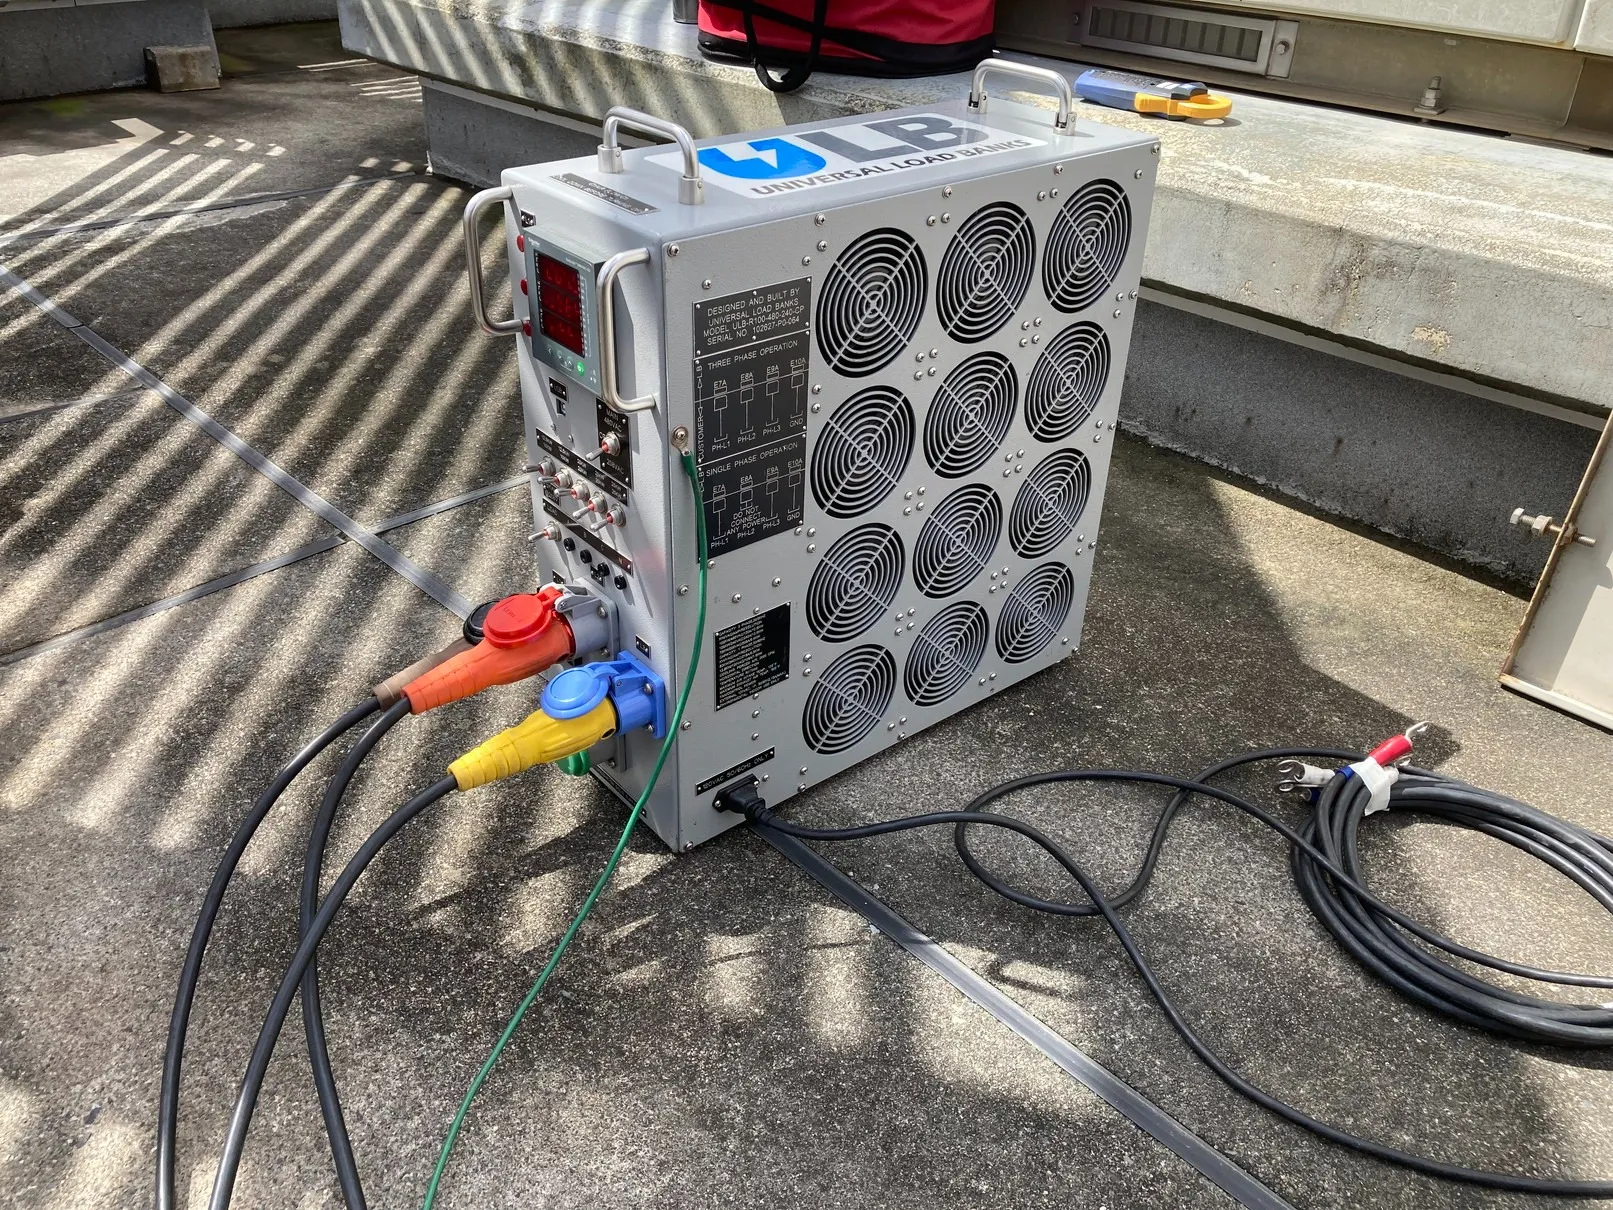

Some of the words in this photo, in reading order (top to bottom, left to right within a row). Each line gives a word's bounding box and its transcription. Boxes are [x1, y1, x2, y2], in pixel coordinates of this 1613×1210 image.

[750, 164, 895, 195] UNIVERSAL
[890, 152, 954, 170] LOAD
[956, 138, 1032, 157] BANKS
[707, 300, 746, 317] DESIGNED
[749, 296, 764, 306] AND
[767, 290, 787, 302] BUILT
[790, 288, 800, 296] BY
[708, 311, 749, 327] UNIVERSAL
[753, 305, 772, 316] LOAD
[775, 298, 799, 310] BANKS
[704, 325, 729, 338] MODEL
[707, 334, 733, 346] SERIAL
[708, 358, 731, 371] THREE
[734, 350, 757, 361] PHASE
[760, 340, 798, 356] OPERATION
[714, 380, 727, 388] E7A
[767, 365, 779, 374] E9A
[790, 358, 806, 367] E10A
[712, 441, 730, 452] PH-L1
[738, 433, 756, 443] PH-L2
[763, 425, 780, 436] PH-L3
[790, 418, 803, 427] GND
[706, 463, 731, 476] SINGLE
[734, 455, 757, 467] PHASE
[760, 442, 798, 459] OPERATION
[713, 484, 726, 493] E7A
[766, 466, 779, 475] E9A
[726, 526, 740, 536] ANY
[742, 517, 766, 530] POWER
[731, 512, 761, 528] CONNECT
[733, 512, 743, 520] DO
[746, 506, 759, 516] NOT
[710, 538, 729, 549] PH-L1
[737, 529, 755, 539] PH-L2
[763, 519, 780, 530] PH-L3
[787, 512, 800, 521] GND
[753, 753, 769, 764] ONLY
